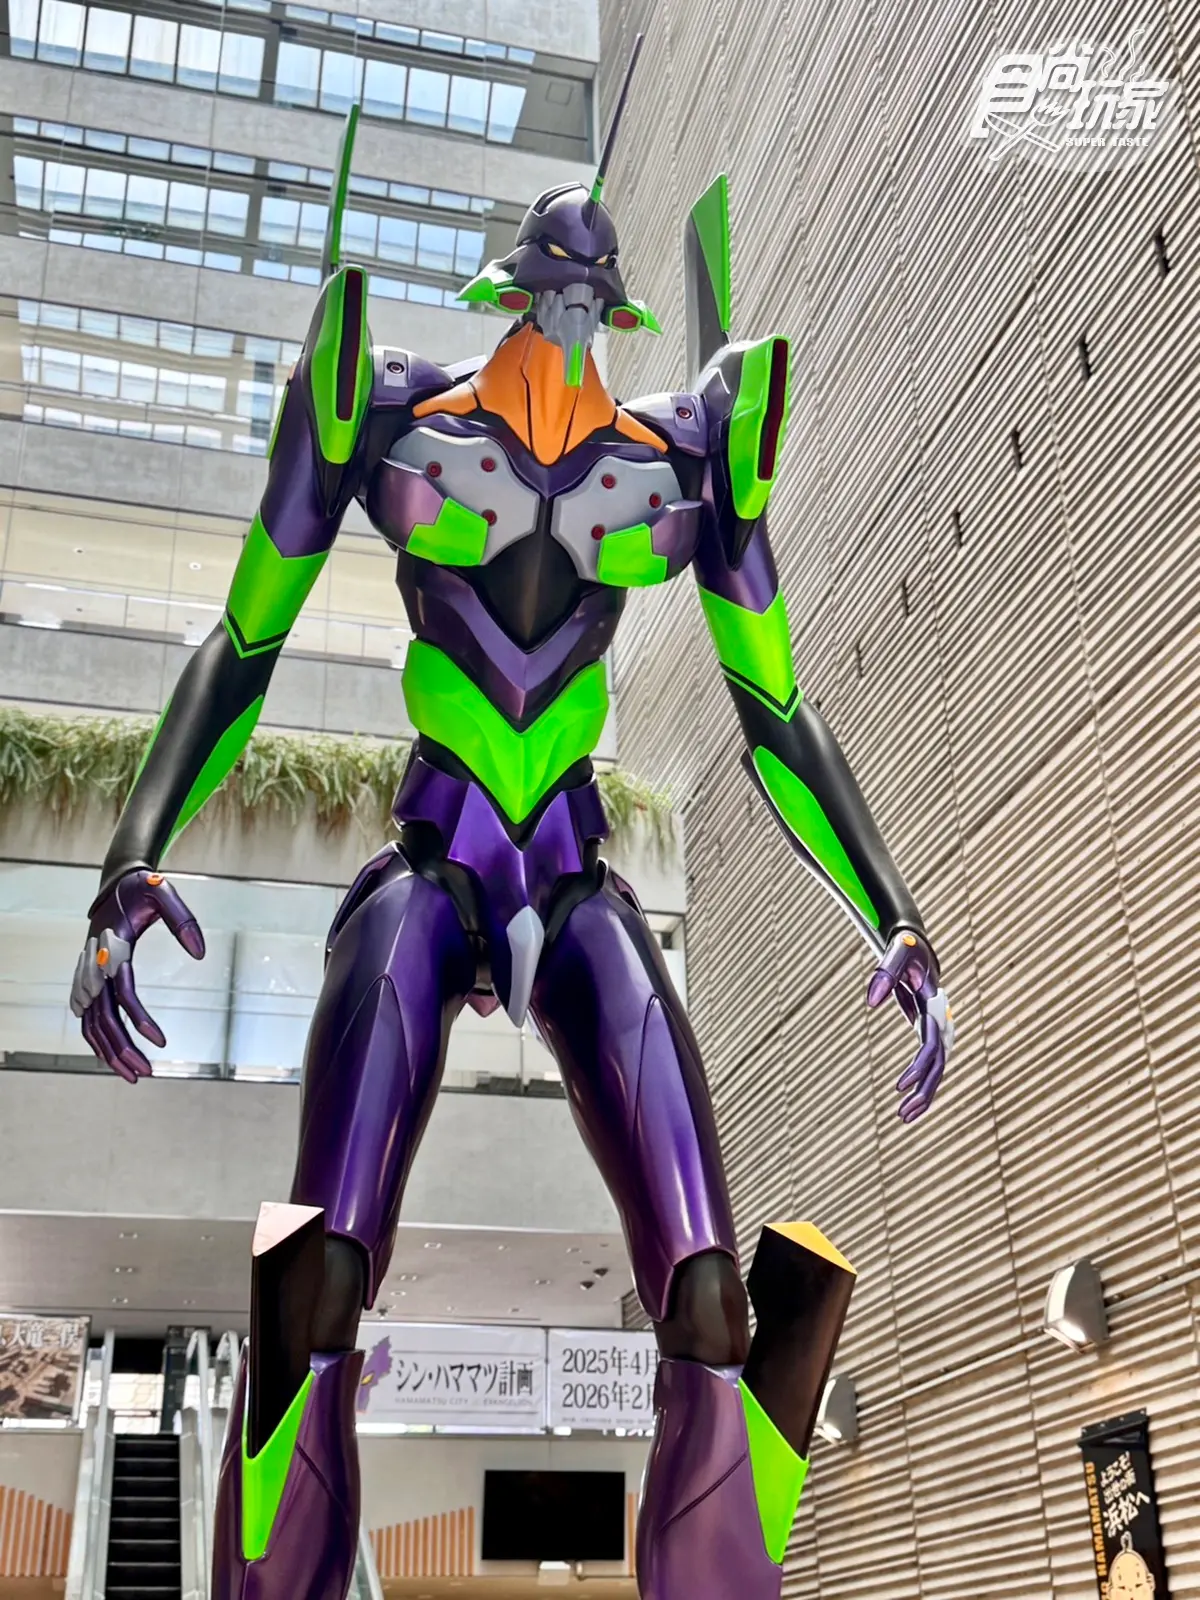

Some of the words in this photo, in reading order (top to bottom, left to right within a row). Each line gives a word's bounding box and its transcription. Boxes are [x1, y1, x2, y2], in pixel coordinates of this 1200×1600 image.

[397, 1359, 533, 1396] シン・ハママツ計画
[562, 1346, 659, 1377] 2025年4月
[1085, 1461, 1107, 1577] HAMAMATSU
[1102, 1491, 1150, 1538] 浜松へ
